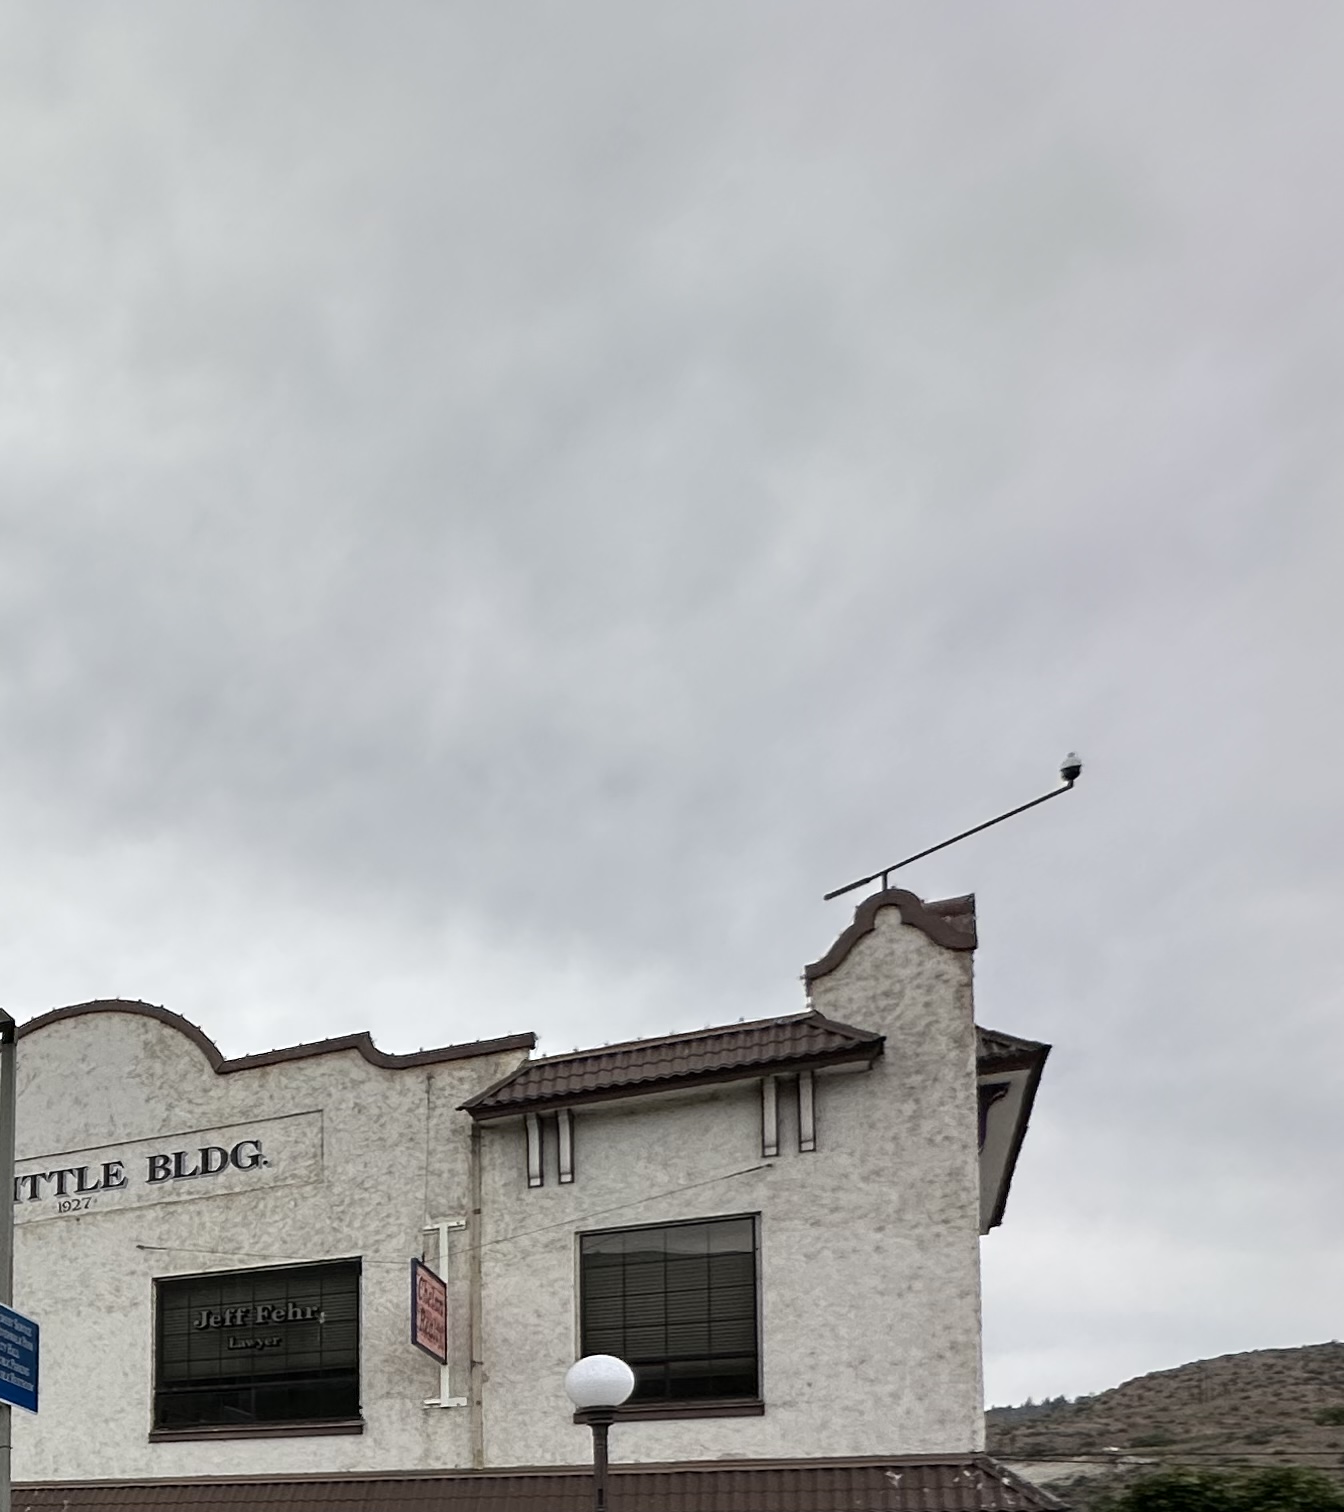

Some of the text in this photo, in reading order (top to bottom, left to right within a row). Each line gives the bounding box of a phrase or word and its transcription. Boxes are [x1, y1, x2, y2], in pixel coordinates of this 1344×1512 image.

[145, 1140, 272, 1184] BLDG.
[57, 1197, 92, 1213] 1927
[193, 1302, 318, 1329] Jeff Fehr
[228, 1336, 282, 1349] Lawyer
